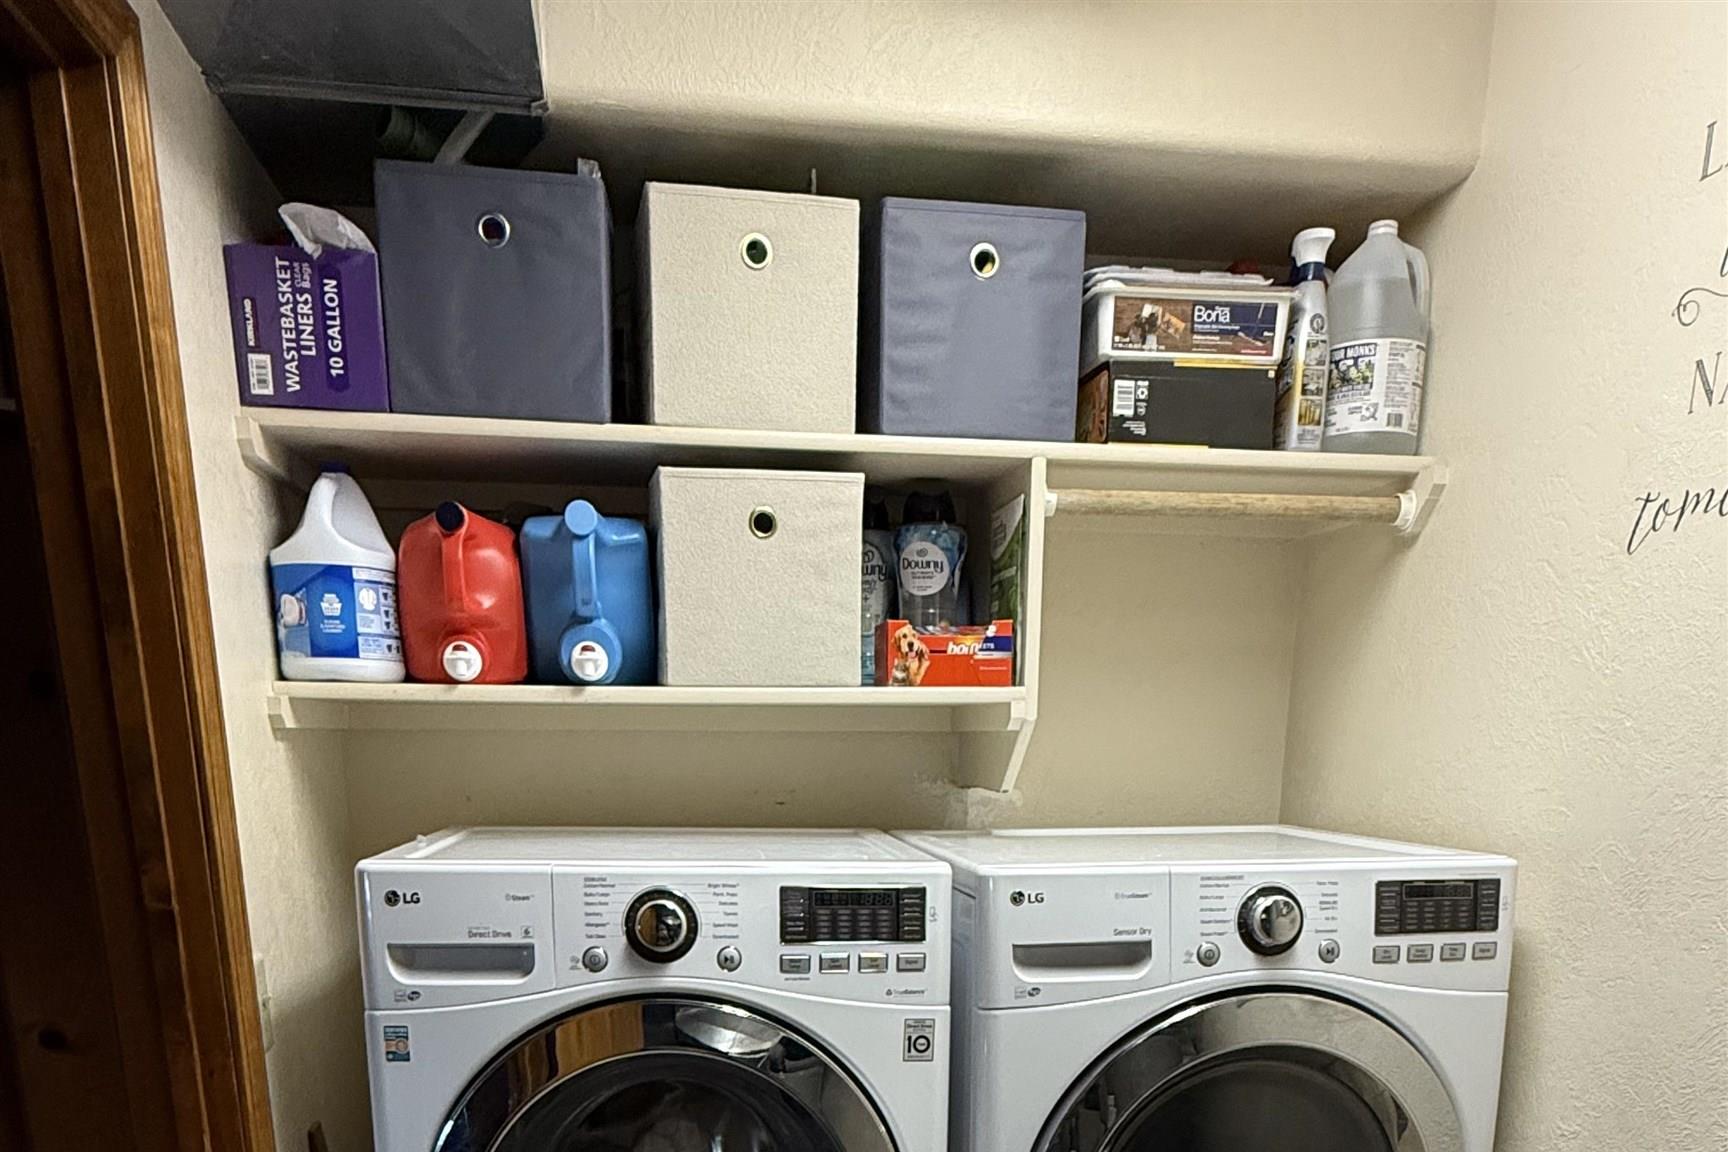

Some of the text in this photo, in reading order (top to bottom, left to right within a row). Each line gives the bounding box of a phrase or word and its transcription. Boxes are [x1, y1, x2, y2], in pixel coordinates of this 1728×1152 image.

[302, 262, 313, 289] Bags
[275, 256, 300, 392] WASTEBASKET
[297, 293, 317, 357] LINERS
[323, 278, 345, 378] 10 GALLON
[902, 557, 944, 574] Downy
[403, 892, 421, 904] LG
[1027, 892, 1045, 904] LG
[1113, 927, 1152, 937] Sensor Dry
[907, 1034, 931, 1054] 10
